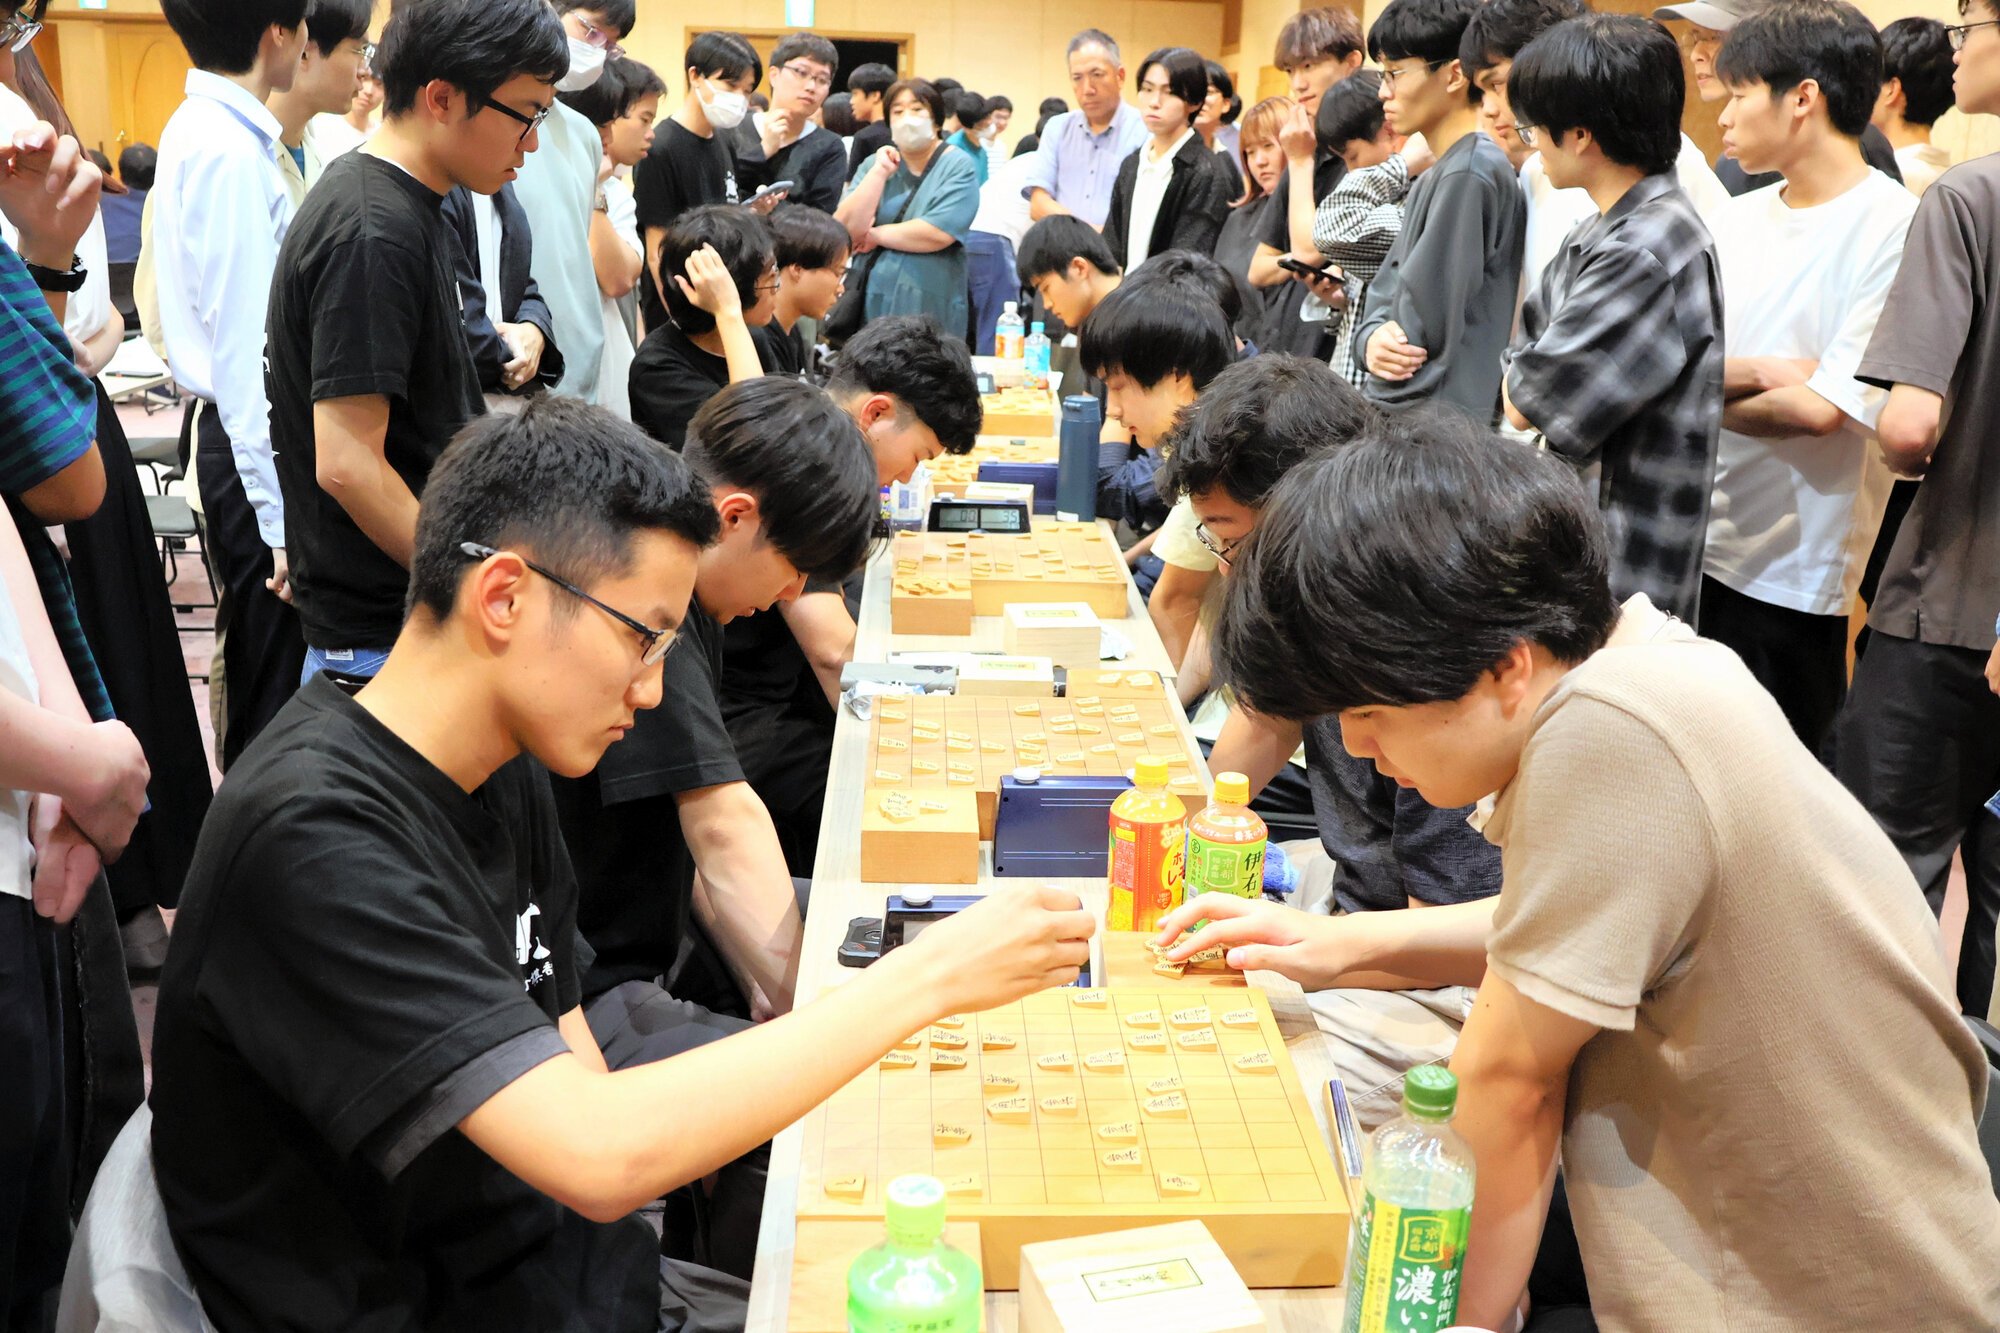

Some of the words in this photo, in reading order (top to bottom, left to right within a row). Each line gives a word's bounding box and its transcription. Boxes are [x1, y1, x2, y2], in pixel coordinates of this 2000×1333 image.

[1241, 850, 1262, 899] 伊右
[1395, 1265, 1436, 1333] 濃い
[1436, 1268, 1458, 1327] 伊右衛門
